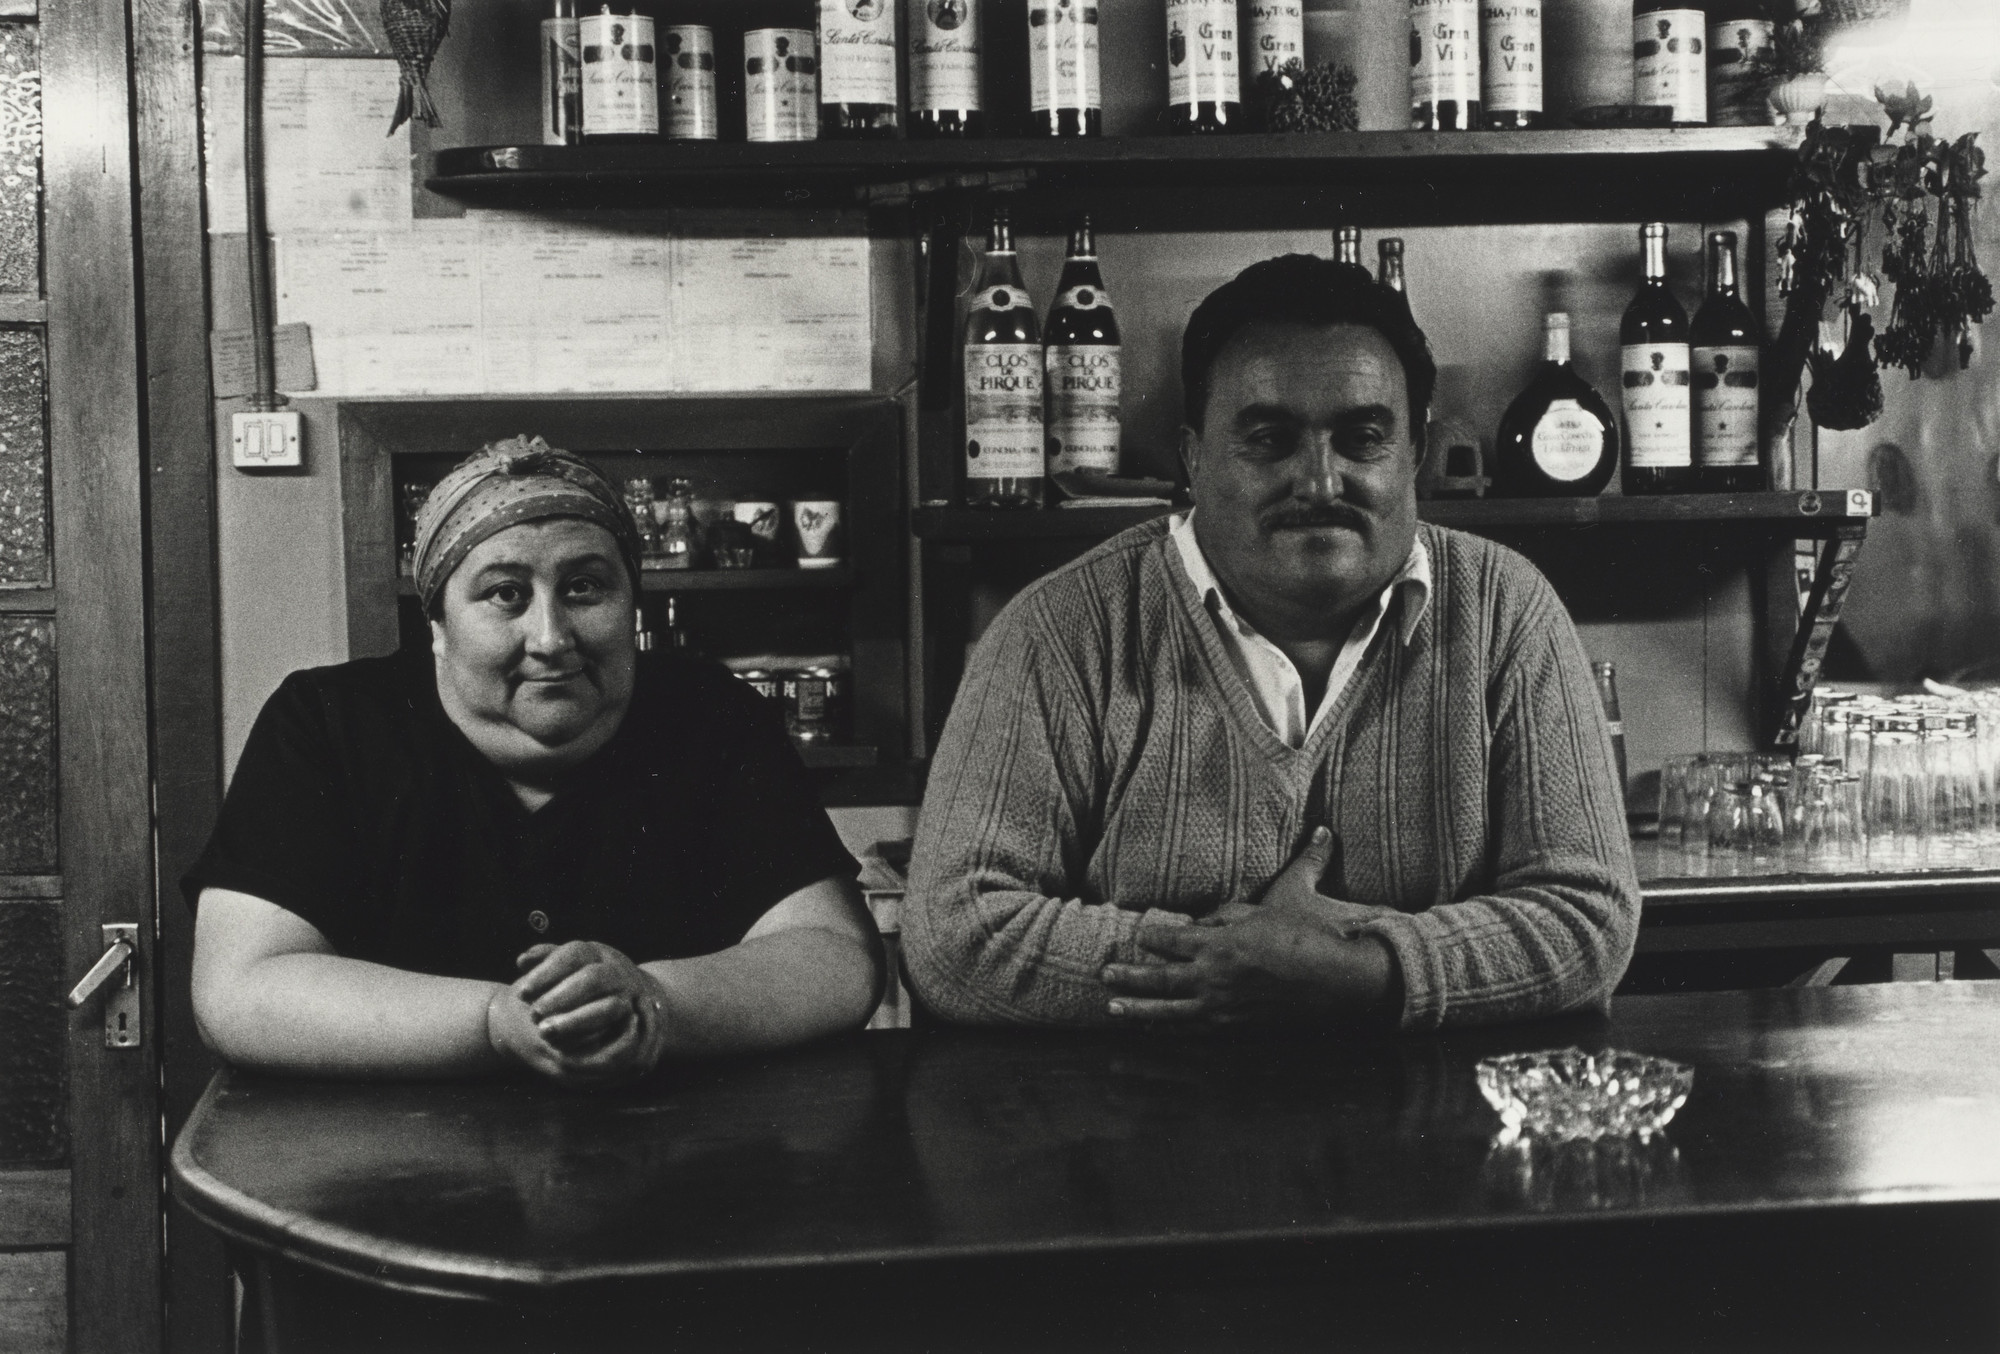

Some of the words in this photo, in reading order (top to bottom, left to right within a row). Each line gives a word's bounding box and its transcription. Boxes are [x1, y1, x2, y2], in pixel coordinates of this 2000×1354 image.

[1433, 22, 1470, 40] Grn
[1203, 43, 1232, 61] Vno
[1436, 44, 1468, 61] Vio
[986, 353, 1029, 368] CLOS
[1068, 354, 1109, 368] CLOS
[980, 375, 1035, 391] PIRQUE
[1062, 375, 1115, 391] PIRQUE
